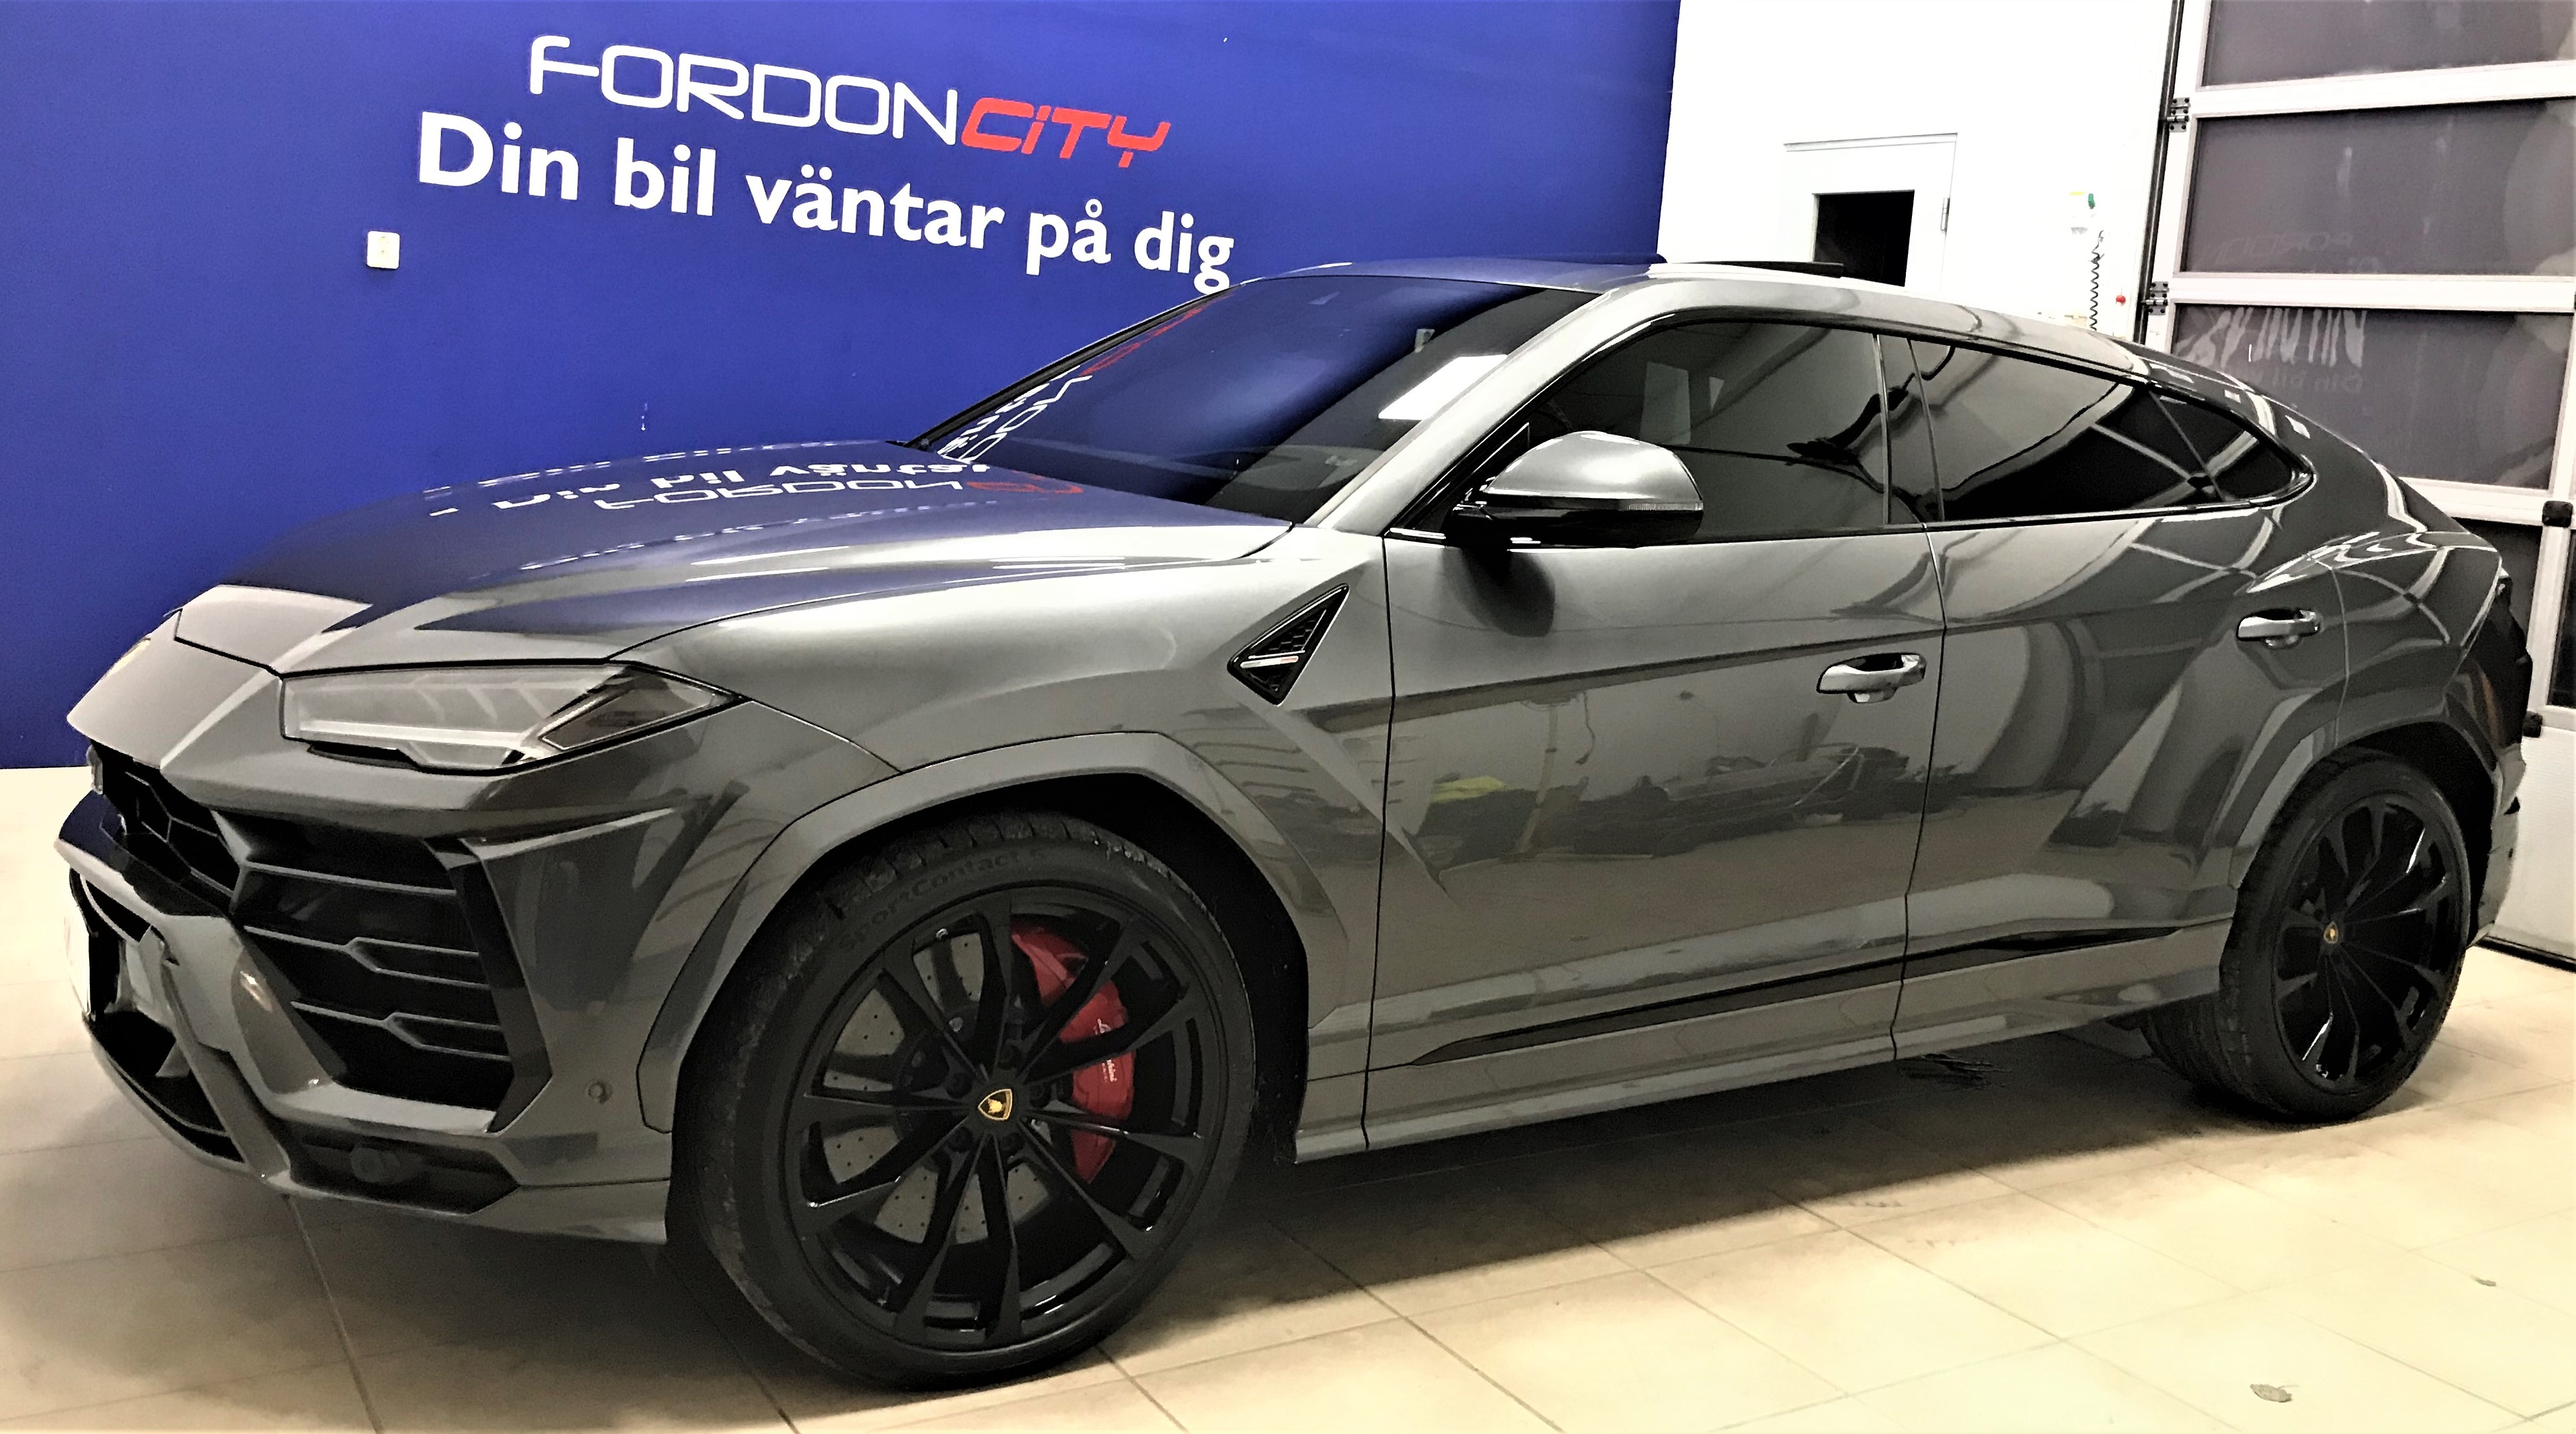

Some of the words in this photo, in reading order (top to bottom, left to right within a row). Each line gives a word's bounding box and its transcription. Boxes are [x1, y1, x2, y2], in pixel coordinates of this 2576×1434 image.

[419, 111, 579, 201] Din
[614, 137, 717, 217] bil
[745, 164, 1005, 249] väntar
[1026, 198, 1113, 276] på
[1134, 210, 1234, 295] dig
